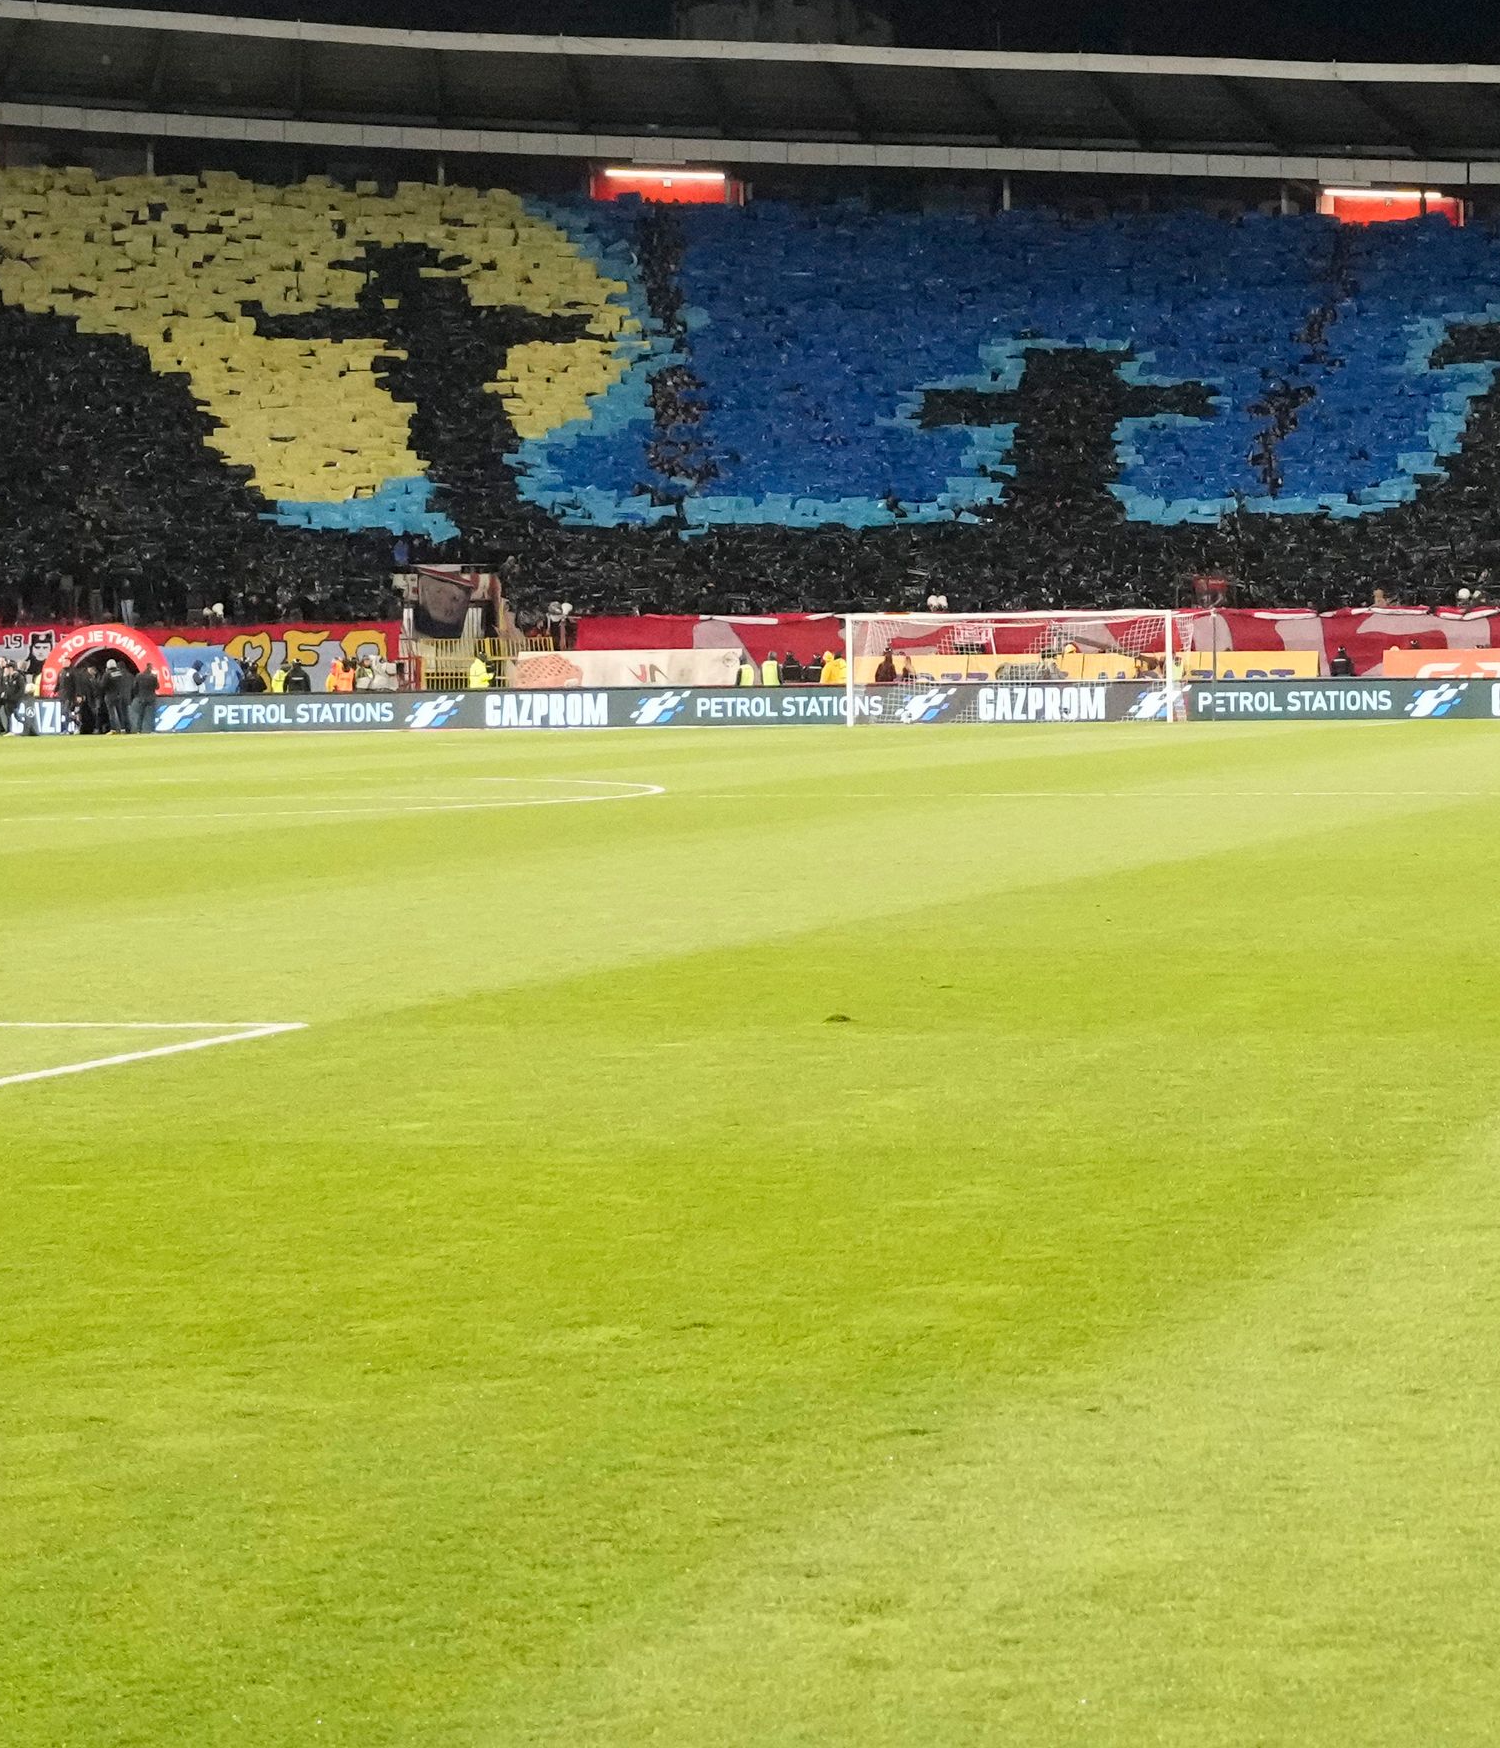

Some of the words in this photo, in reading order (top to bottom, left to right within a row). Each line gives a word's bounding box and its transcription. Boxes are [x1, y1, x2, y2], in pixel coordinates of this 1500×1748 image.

[485, 693, 608, 726] GAZPROM
[696, 697, 778, 718] PETROL
[978, 687, 1106, 721] GAZPROM
[1199, 691, 1283, 713] PETROL
[1286, 689, 1392, 712] STATIONS
[214, 704, 292, 725] PETROL
[297, 703, 394, 724] STATIONS
